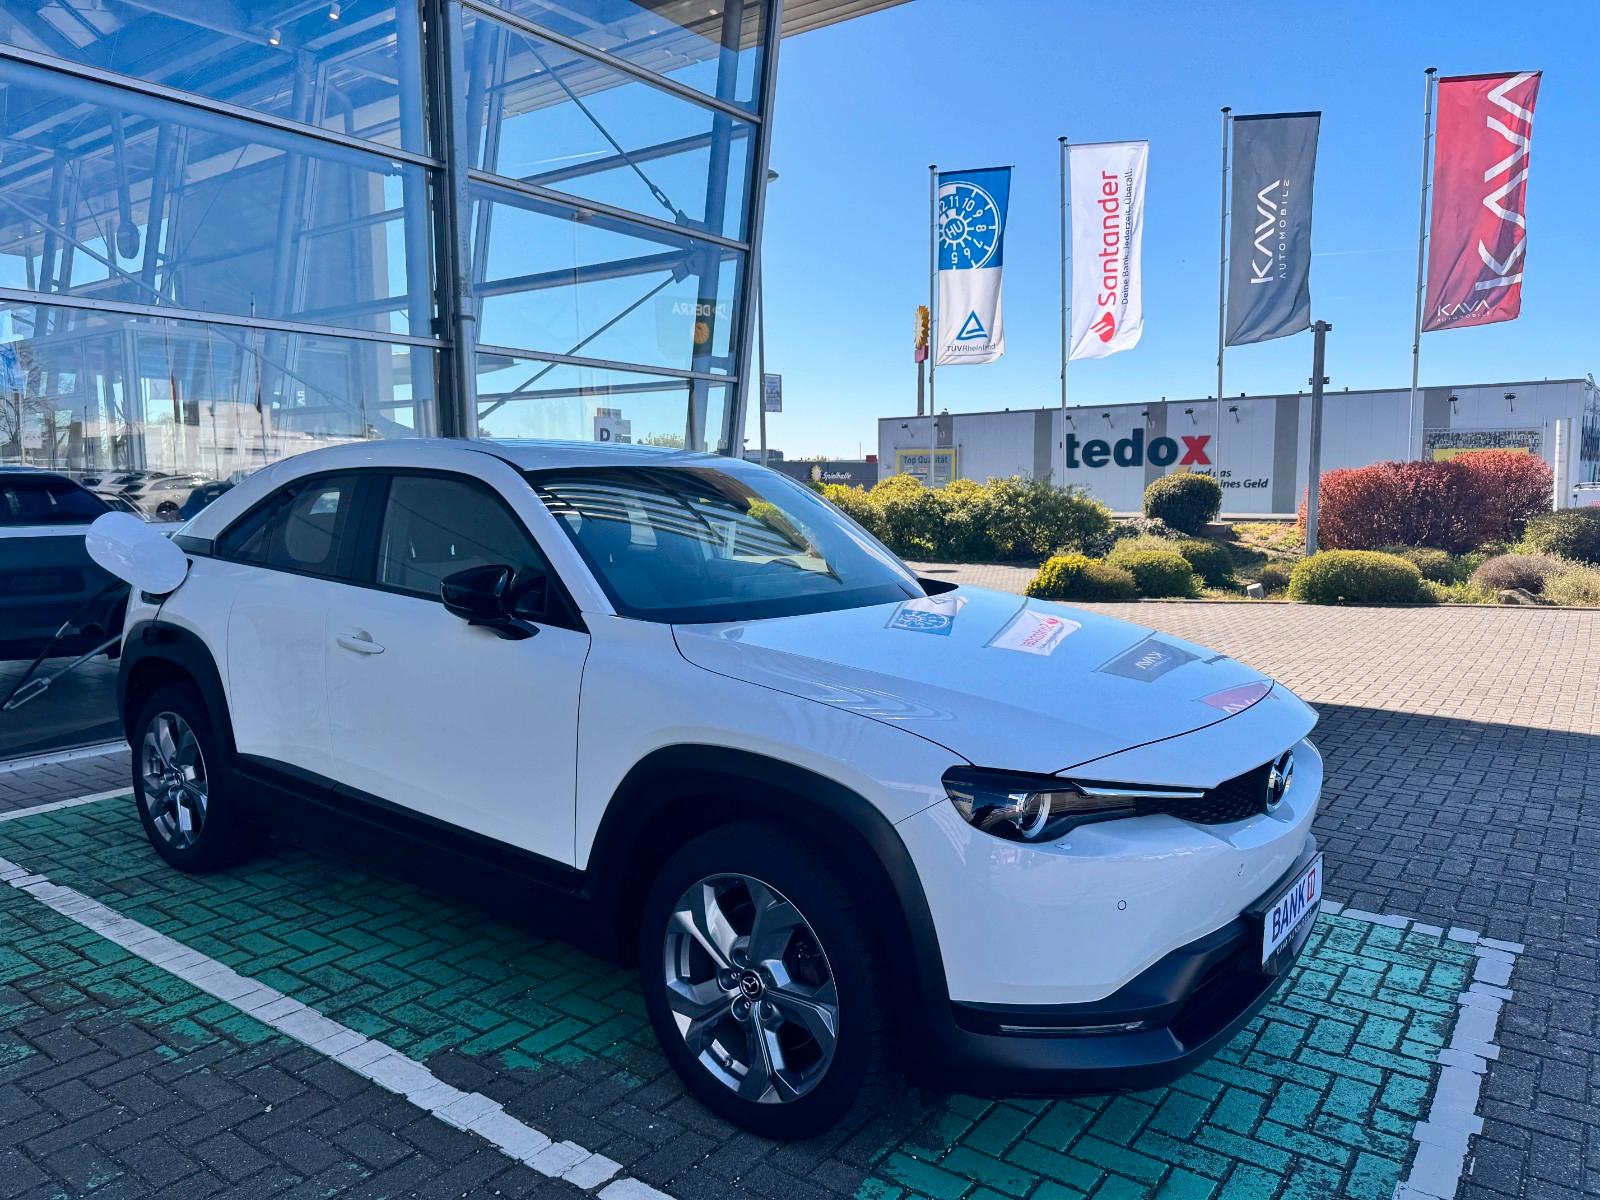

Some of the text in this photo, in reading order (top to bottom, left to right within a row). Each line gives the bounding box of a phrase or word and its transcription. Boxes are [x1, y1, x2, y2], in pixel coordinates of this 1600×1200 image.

[1124, 168, 1133, 205] Überall.
[1475, 71, 1537, 291] KAVA
[949, 195, 959, 208] 11
[962, 197, 975, 212] 10
[945, 220, 963, 239] HU
[975, 224, 987, 232] 8
[1250, 180, 1280, 284] KAVA
[1097, 170, 1120, 307] Santander
[951, 252, 958, 264] 5
[1121, 279, 1129, 305] Deine
[1437, 299, 1490, 317] KAVA
[1065, 428, 1212, 469] tedox
[903, 455, 948, 465] Top Quaität
[1243, 479, 1269, 489] Geld
[1272, 879, 1305, 944] BANK
